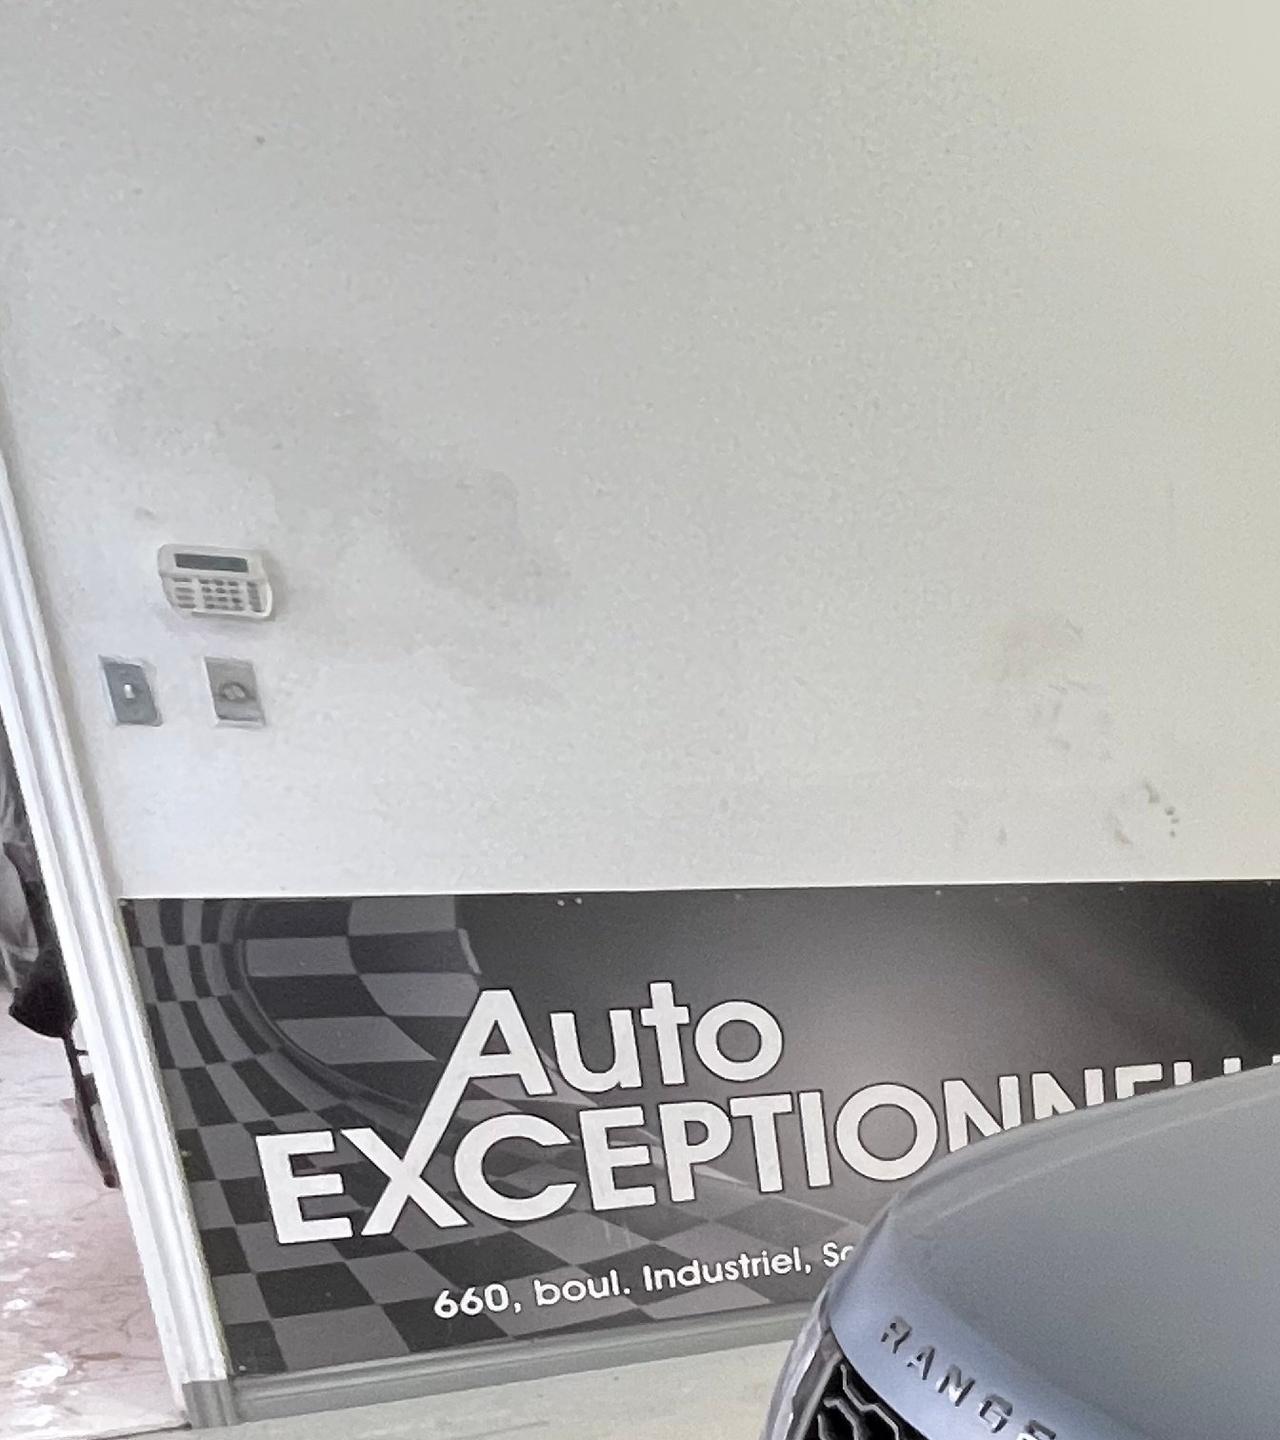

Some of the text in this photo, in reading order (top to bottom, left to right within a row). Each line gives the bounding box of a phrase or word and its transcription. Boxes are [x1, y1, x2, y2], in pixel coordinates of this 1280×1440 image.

[426, 980, 785, 1097] Auto
[433, 1283, 522, 1319] 660,
[532, 1269, 632, 1307] boul.
[642, 1245, 812, 1292] Industriel,
